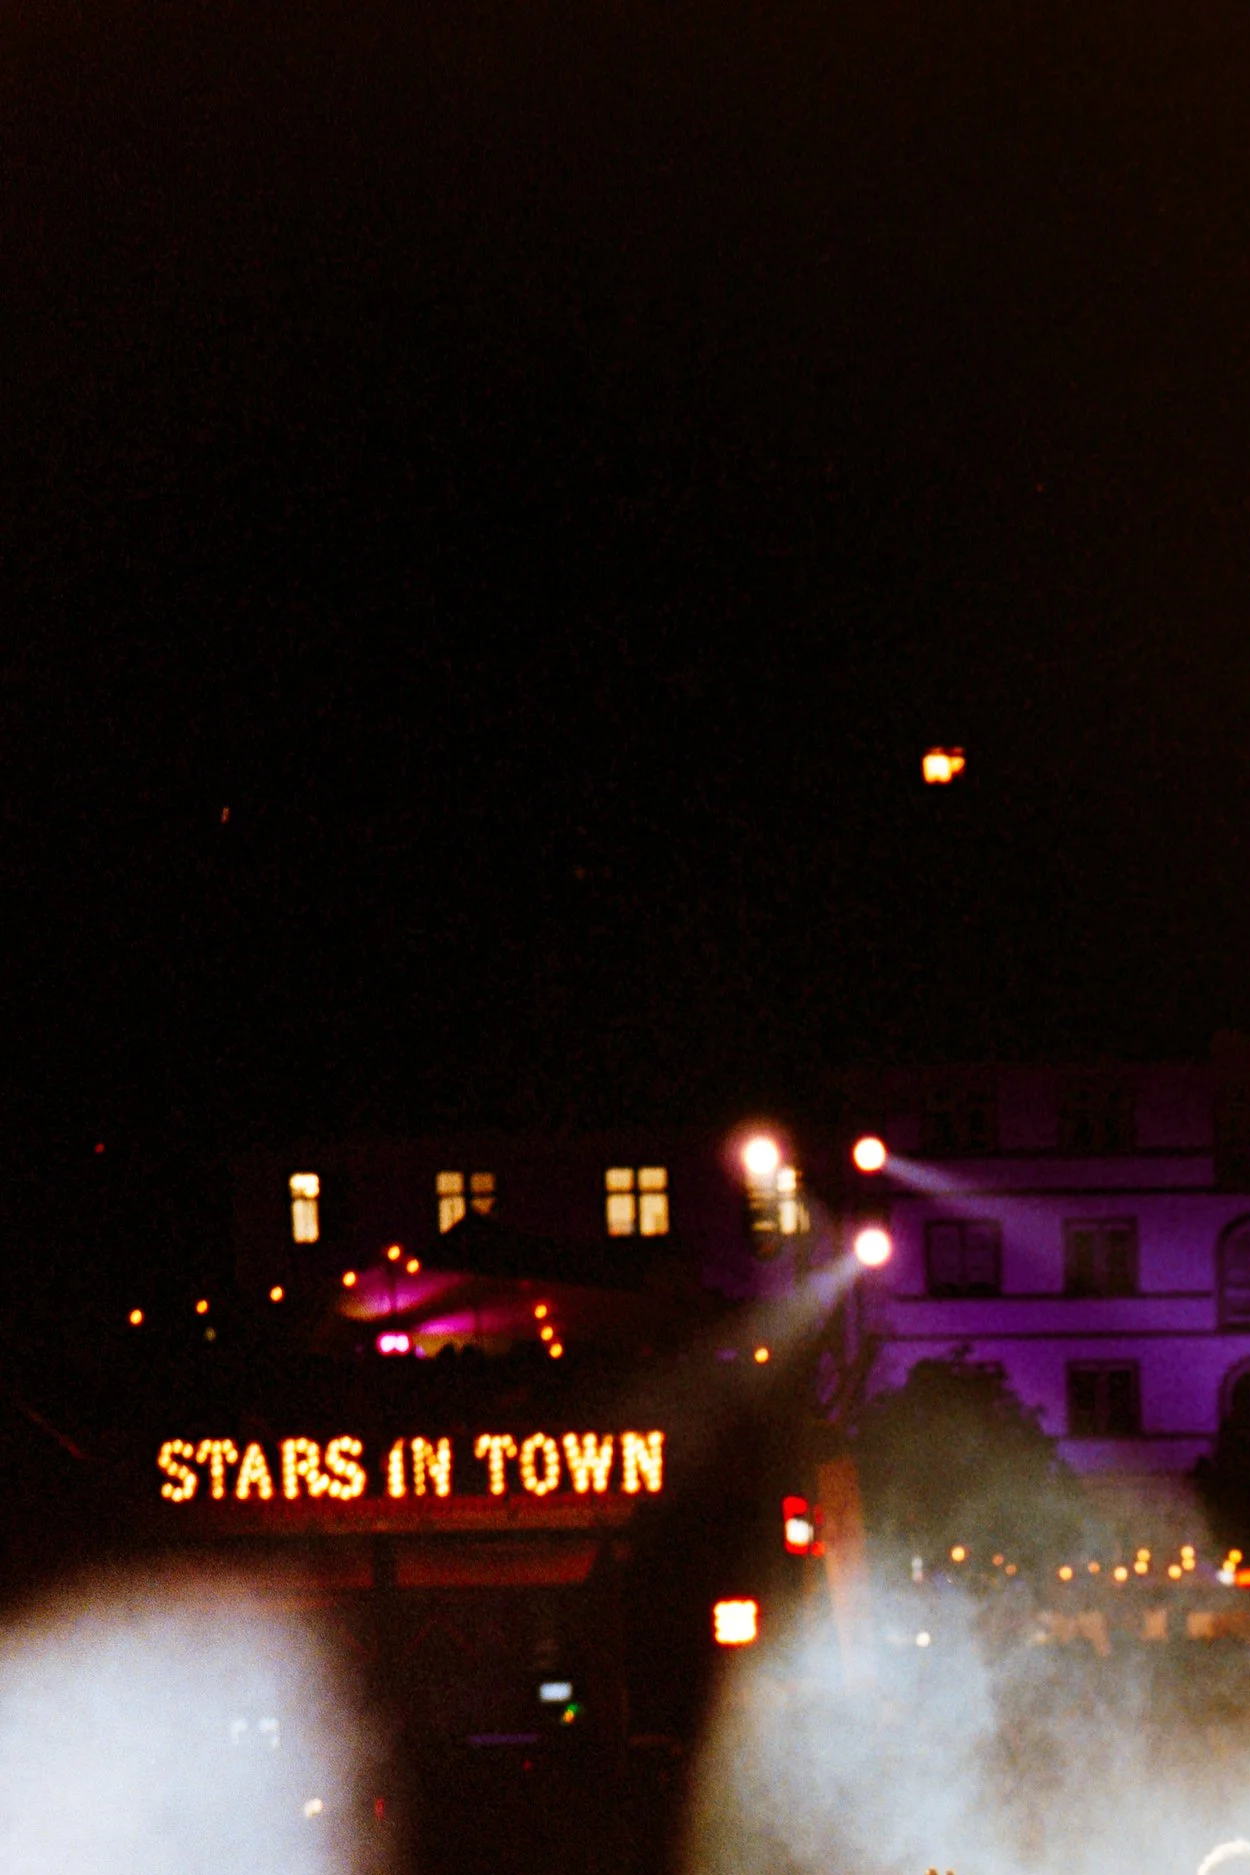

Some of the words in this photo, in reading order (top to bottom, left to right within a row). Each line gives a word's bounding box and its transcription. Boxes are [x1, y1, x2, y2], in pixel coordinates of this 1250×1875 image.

[157, 1435, 366, 1502] STARS
[386, 1435, 451, 1499] IN
[474, 1430, 664, 1496] TOWN
